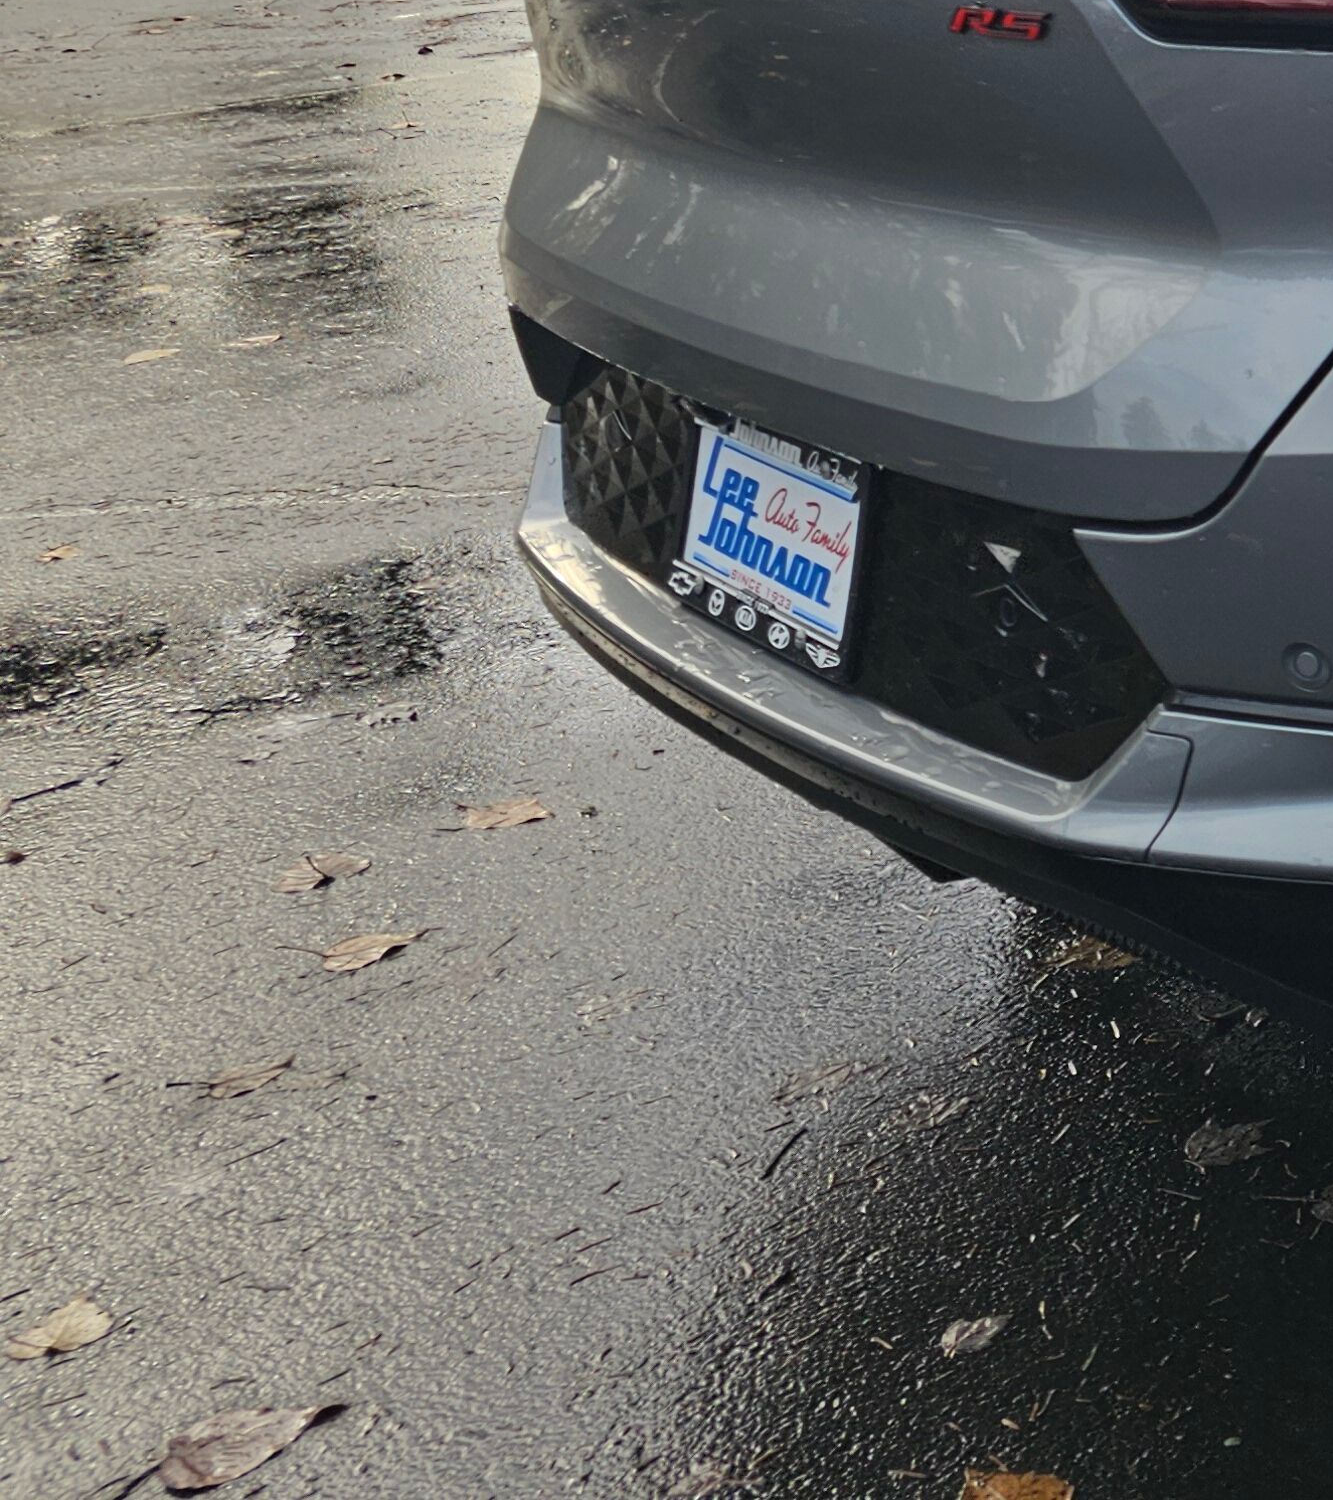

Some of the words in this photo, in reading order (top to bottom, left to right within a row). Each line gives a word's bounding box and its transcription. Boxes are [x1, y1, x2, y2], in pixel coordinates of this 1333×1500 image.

[948, 6, 1053, 41] RS
[703, 436, 760, 514] Lee
[698, 500, 831, 608] Johnson
[765, 488, 800, 533] Auto
[804, 502, 851, 572] Family
[730, 569, 762, 596] SINCE
